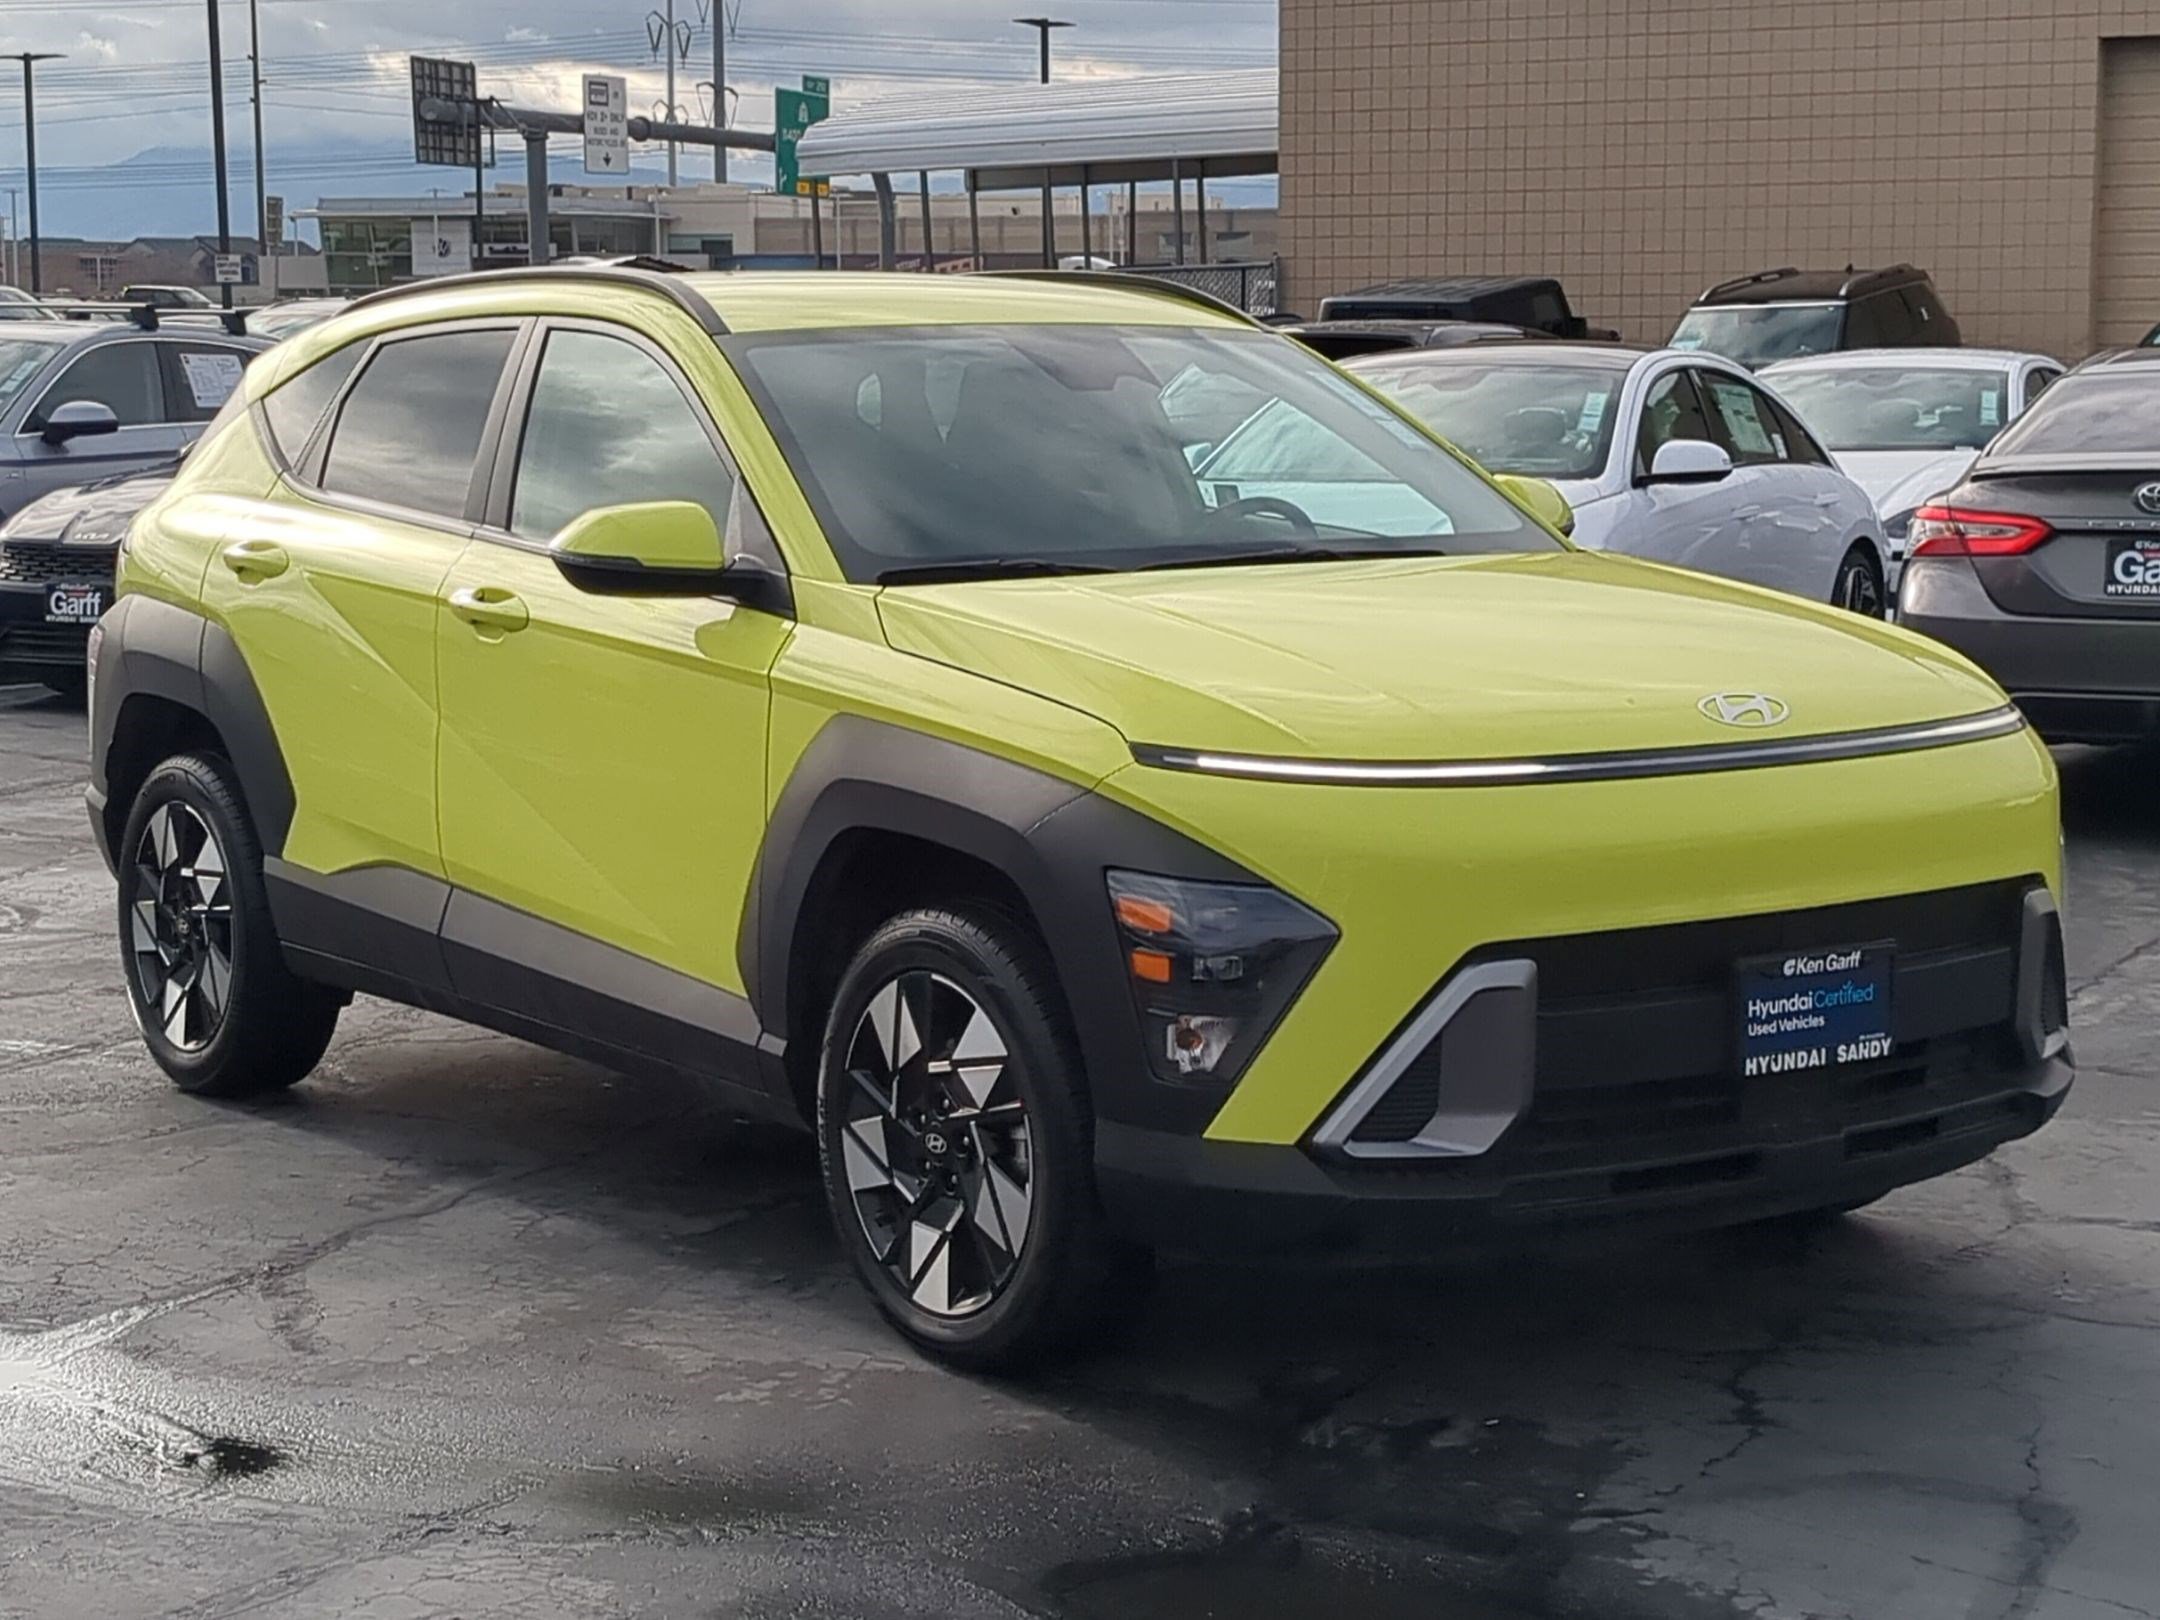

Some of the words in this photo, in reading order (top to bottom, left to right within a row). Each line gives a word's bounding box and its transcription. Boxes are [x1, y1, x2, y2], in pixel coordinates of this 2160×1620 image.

[2107, 584, 2160, 594] HYUNDA
[50, 591, 101, 616] Garff
[1796, 956, 1824, 975] Ken
[1825, 950, 1862, 972] Garff
[1747, 990, 1813, 1020] Hyundai
[1813, 980, 1874, 1008] Certified
[1747, 1020, 1778, 1037] Used
[1779, 1014, 1825, 1032] Vehicles
[1744, 1047, 1826, 1076] HYUNDAI
[1836, 1037, 1892, 1063] SANDY
